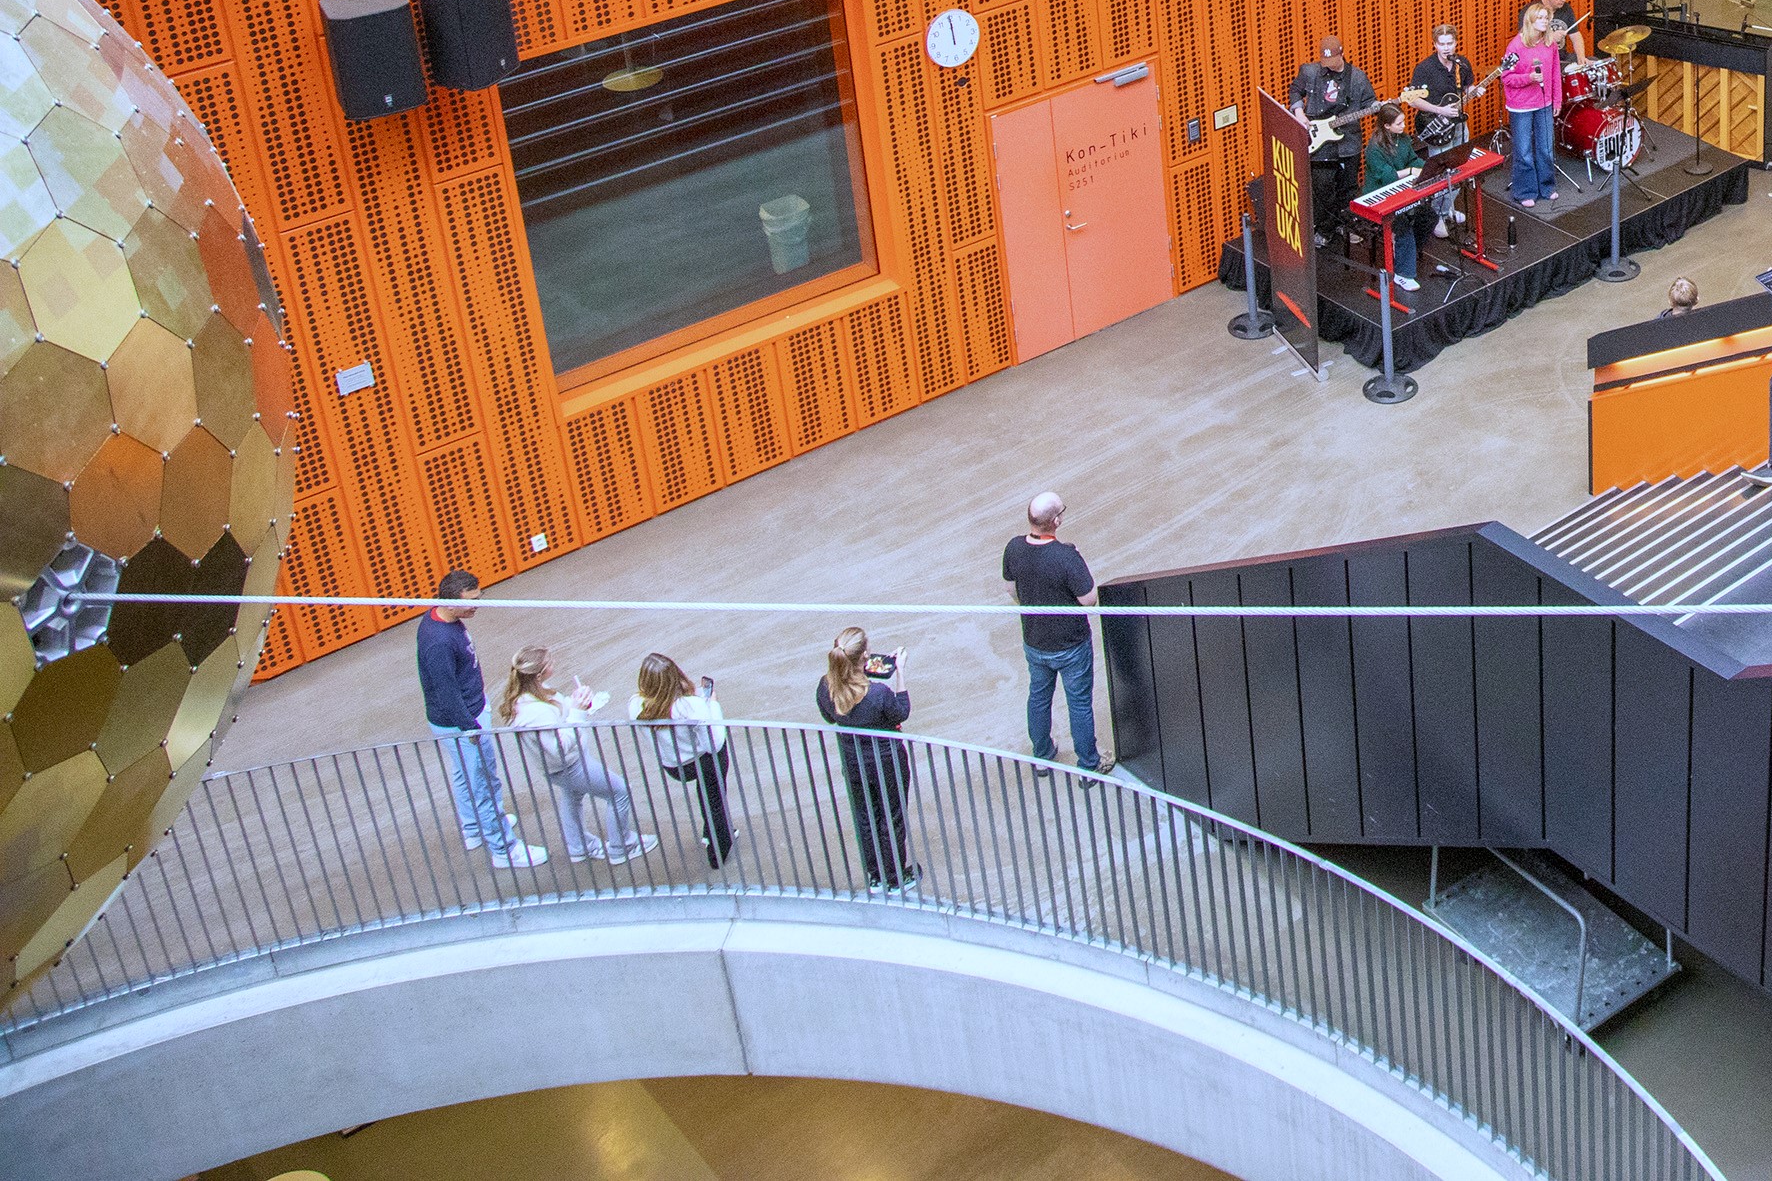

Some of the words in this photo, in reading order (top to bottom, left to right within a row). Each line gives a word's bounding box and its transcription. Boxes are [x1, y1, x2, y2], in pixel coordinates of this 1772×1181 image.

[1066, 123, 1147, 164] Kon-Tiki
[1068, 150, 1130, 177] Auditorium
[1272, 135, 1299, 189] KUL
[1069, 175, 1094, 191] S251
[1273, 169, 1300, 224] TUR
[1276, 202, 1303, 258] UKA
